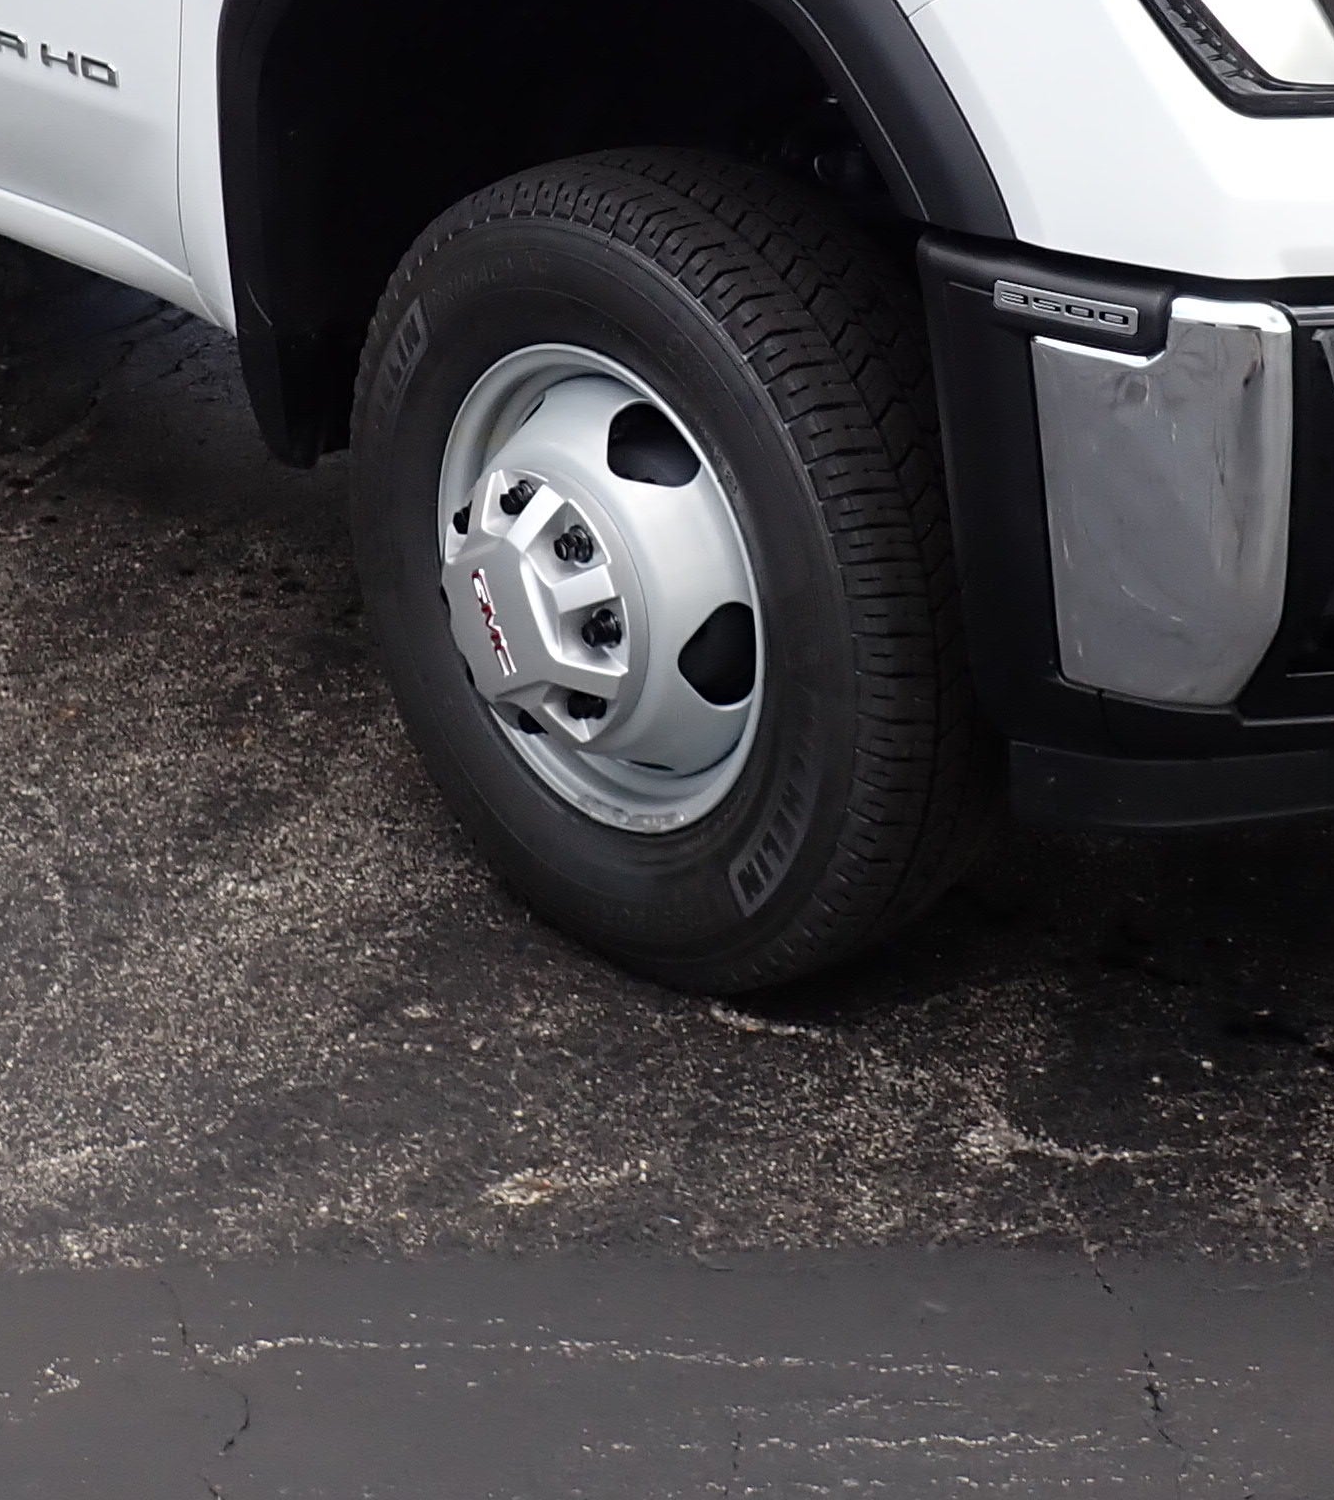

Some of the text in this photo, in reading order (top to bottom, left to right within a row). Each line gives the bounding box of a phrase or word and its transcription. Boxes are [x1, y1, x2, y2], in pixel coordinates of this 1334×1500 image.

[40, 41, 120, 88] HD
[999, 290, 1130, 328] 3500
[471, 567, 518, 678] GMC
